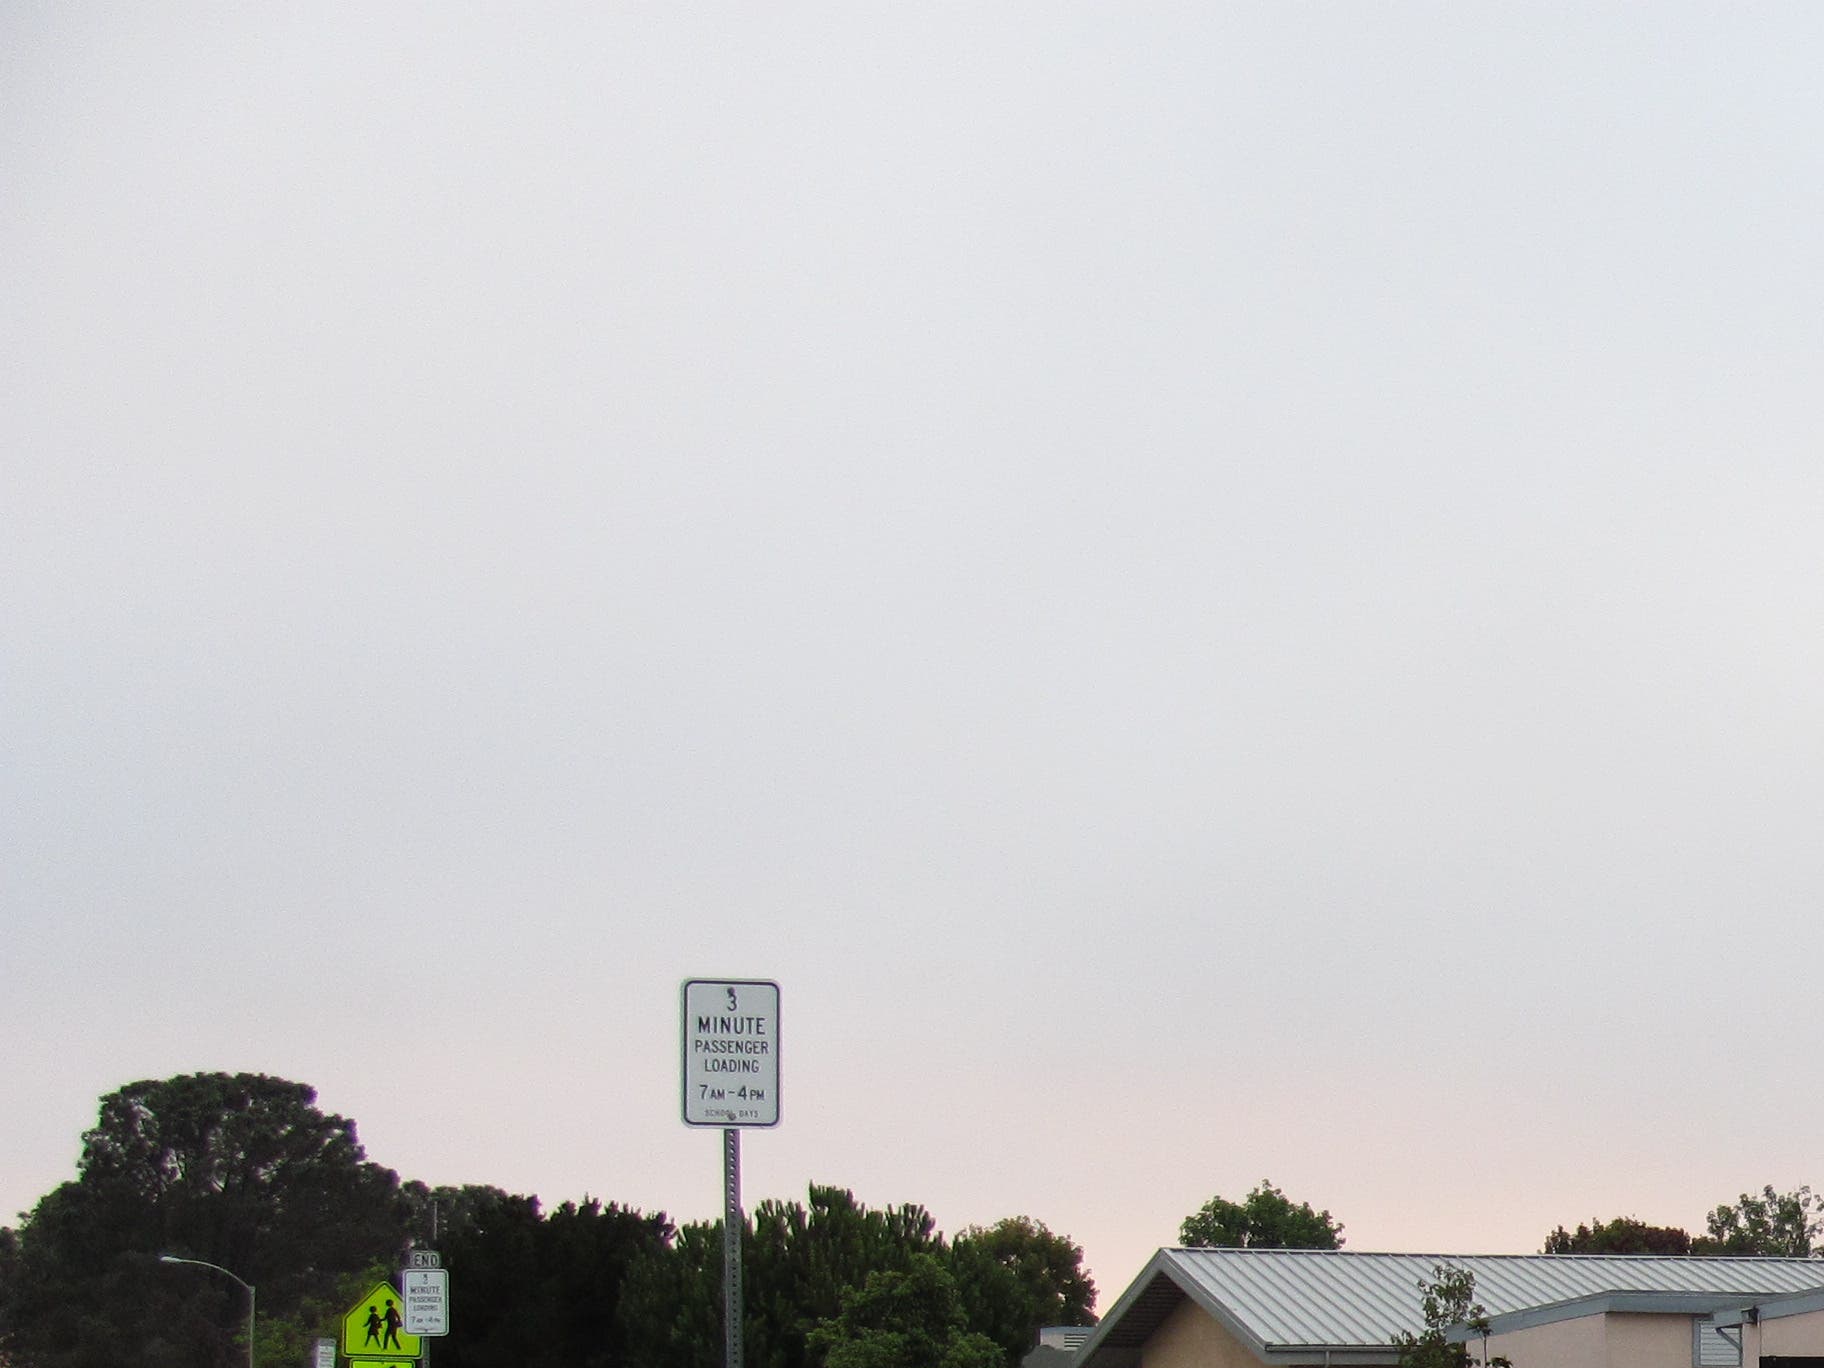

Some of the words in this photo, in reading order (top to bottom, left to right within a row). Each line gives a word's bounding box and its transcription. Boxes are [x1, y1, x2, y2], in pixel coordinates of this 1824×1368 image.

[726, 990, 738, 1012] 3
[698, 1016, 766, 1035] MINUTE
[695, 1039, 769, 1055] PASSENGER
[704, 1059, 760, 1073] LOADING
[414, 1254, 438, 1267] END
[410, 1286, 440, 1294] MINUTE
